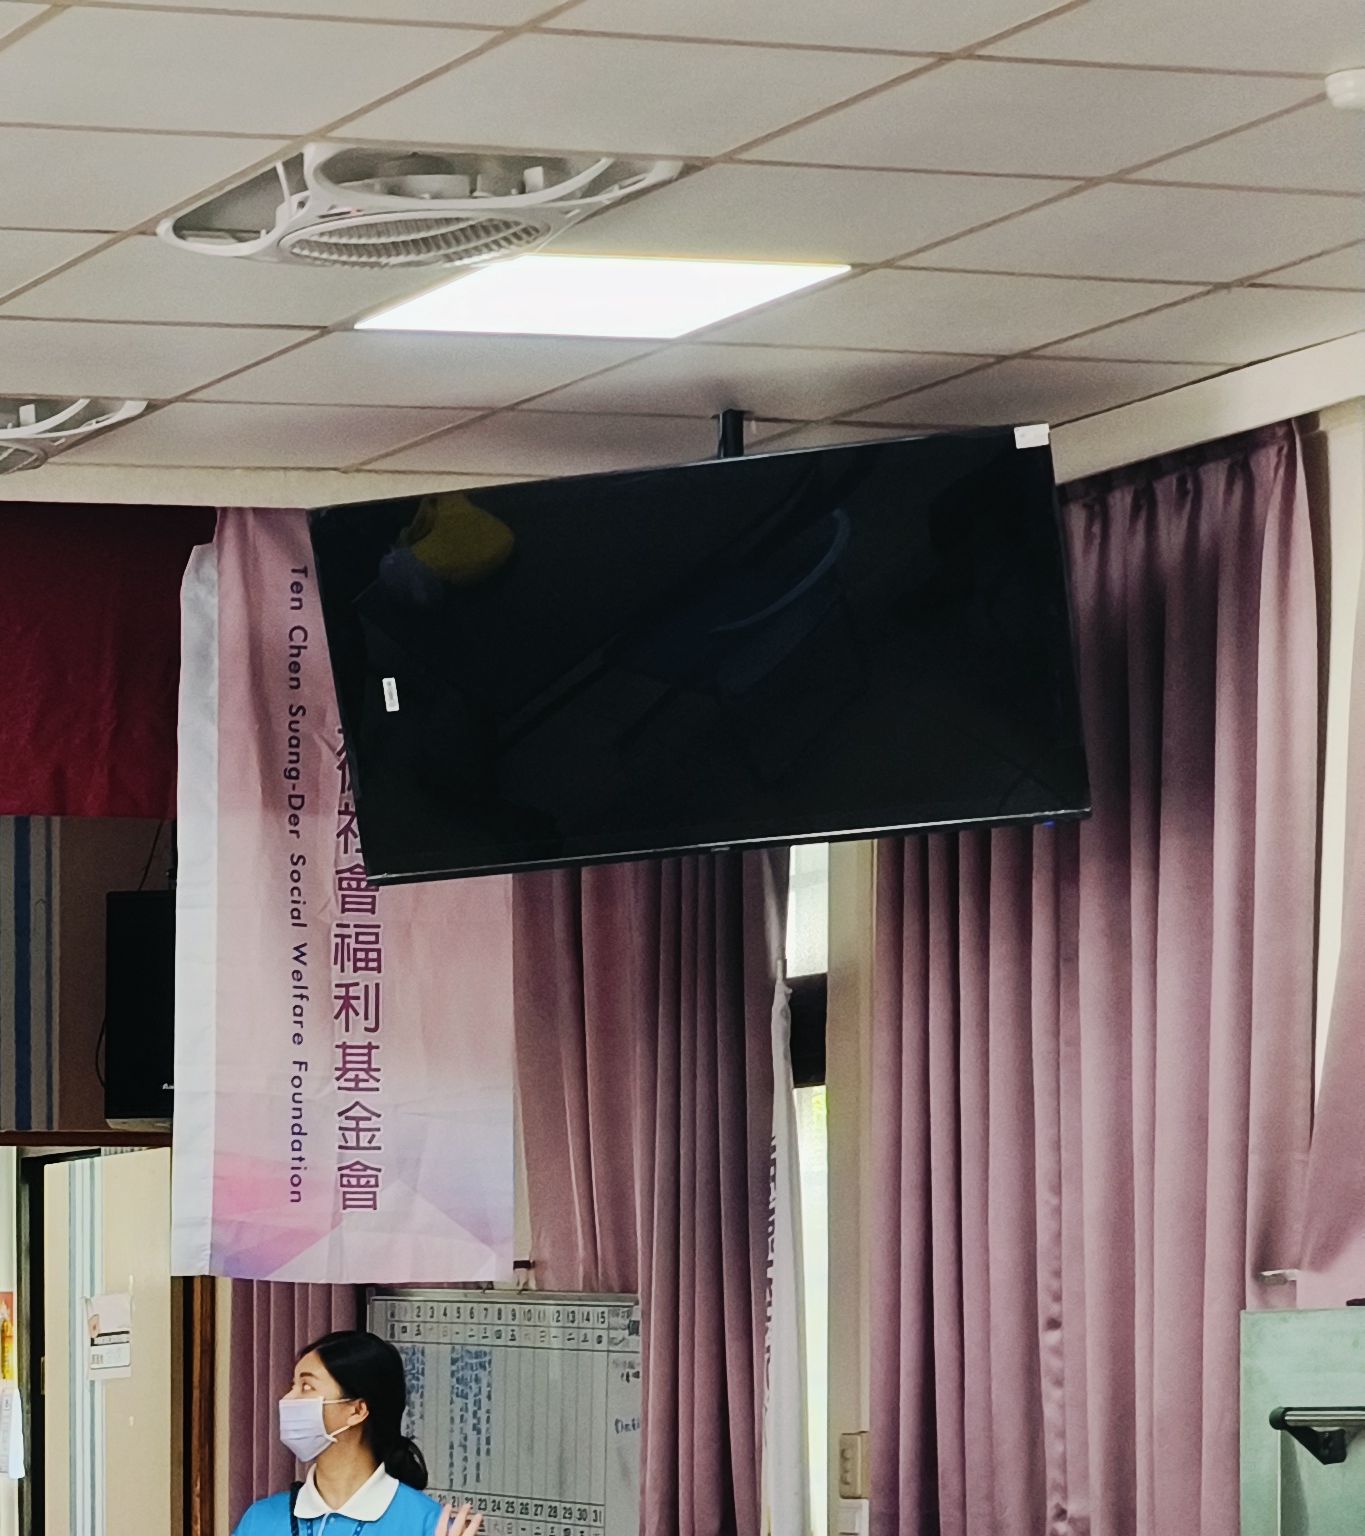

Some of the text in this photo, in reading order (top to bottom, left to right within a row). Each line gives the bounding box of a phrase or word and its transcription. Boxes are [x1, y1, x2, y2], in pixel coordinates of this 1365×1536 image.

[283, 565, 310, 1204] Ten Chen Suang-Der Social Welfare Foundation
[332, 725, 384, 1212] 社會福利基金會
